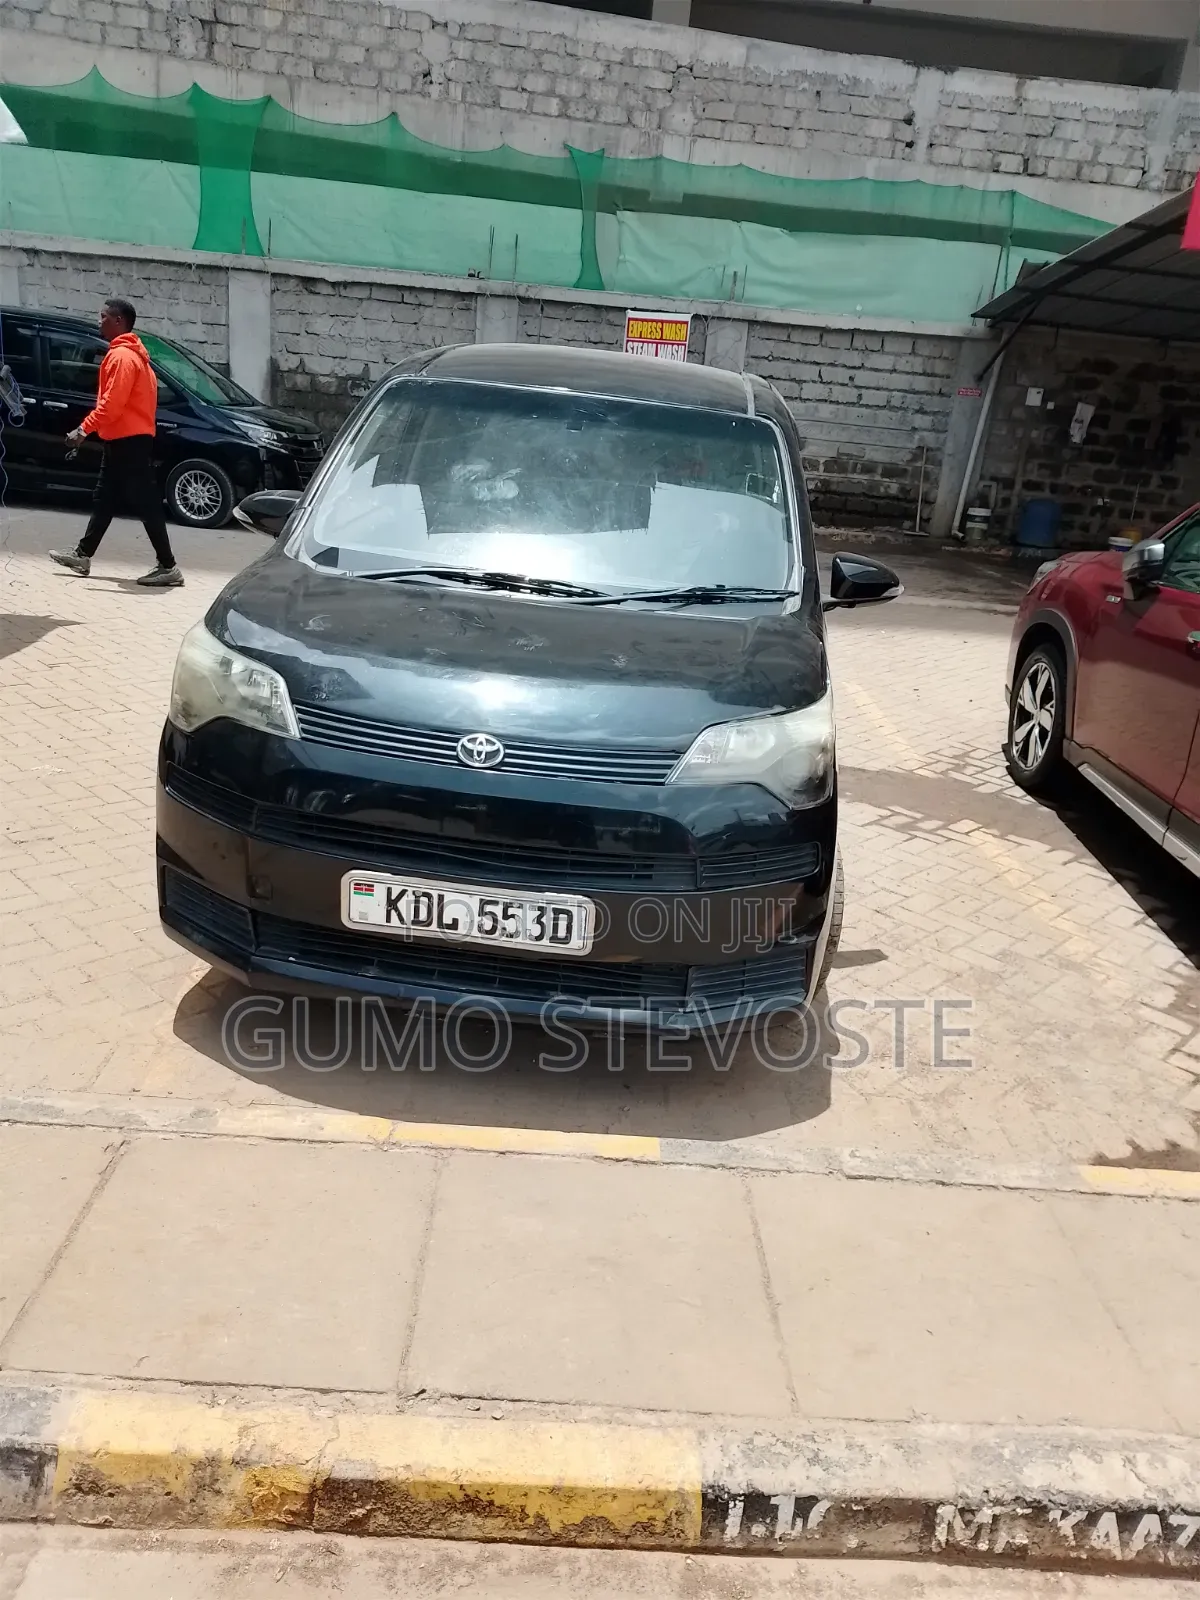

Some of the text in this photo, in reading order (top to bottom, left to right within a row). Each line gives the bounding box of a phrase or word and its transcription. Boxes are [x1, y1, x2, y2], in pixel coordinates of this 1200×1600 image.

[628, 320, 687, 341] EXPRESS WASH
[627, 341, 685, 361] STEAM WASH
[385, 886, 574, 945] KDL 553D
